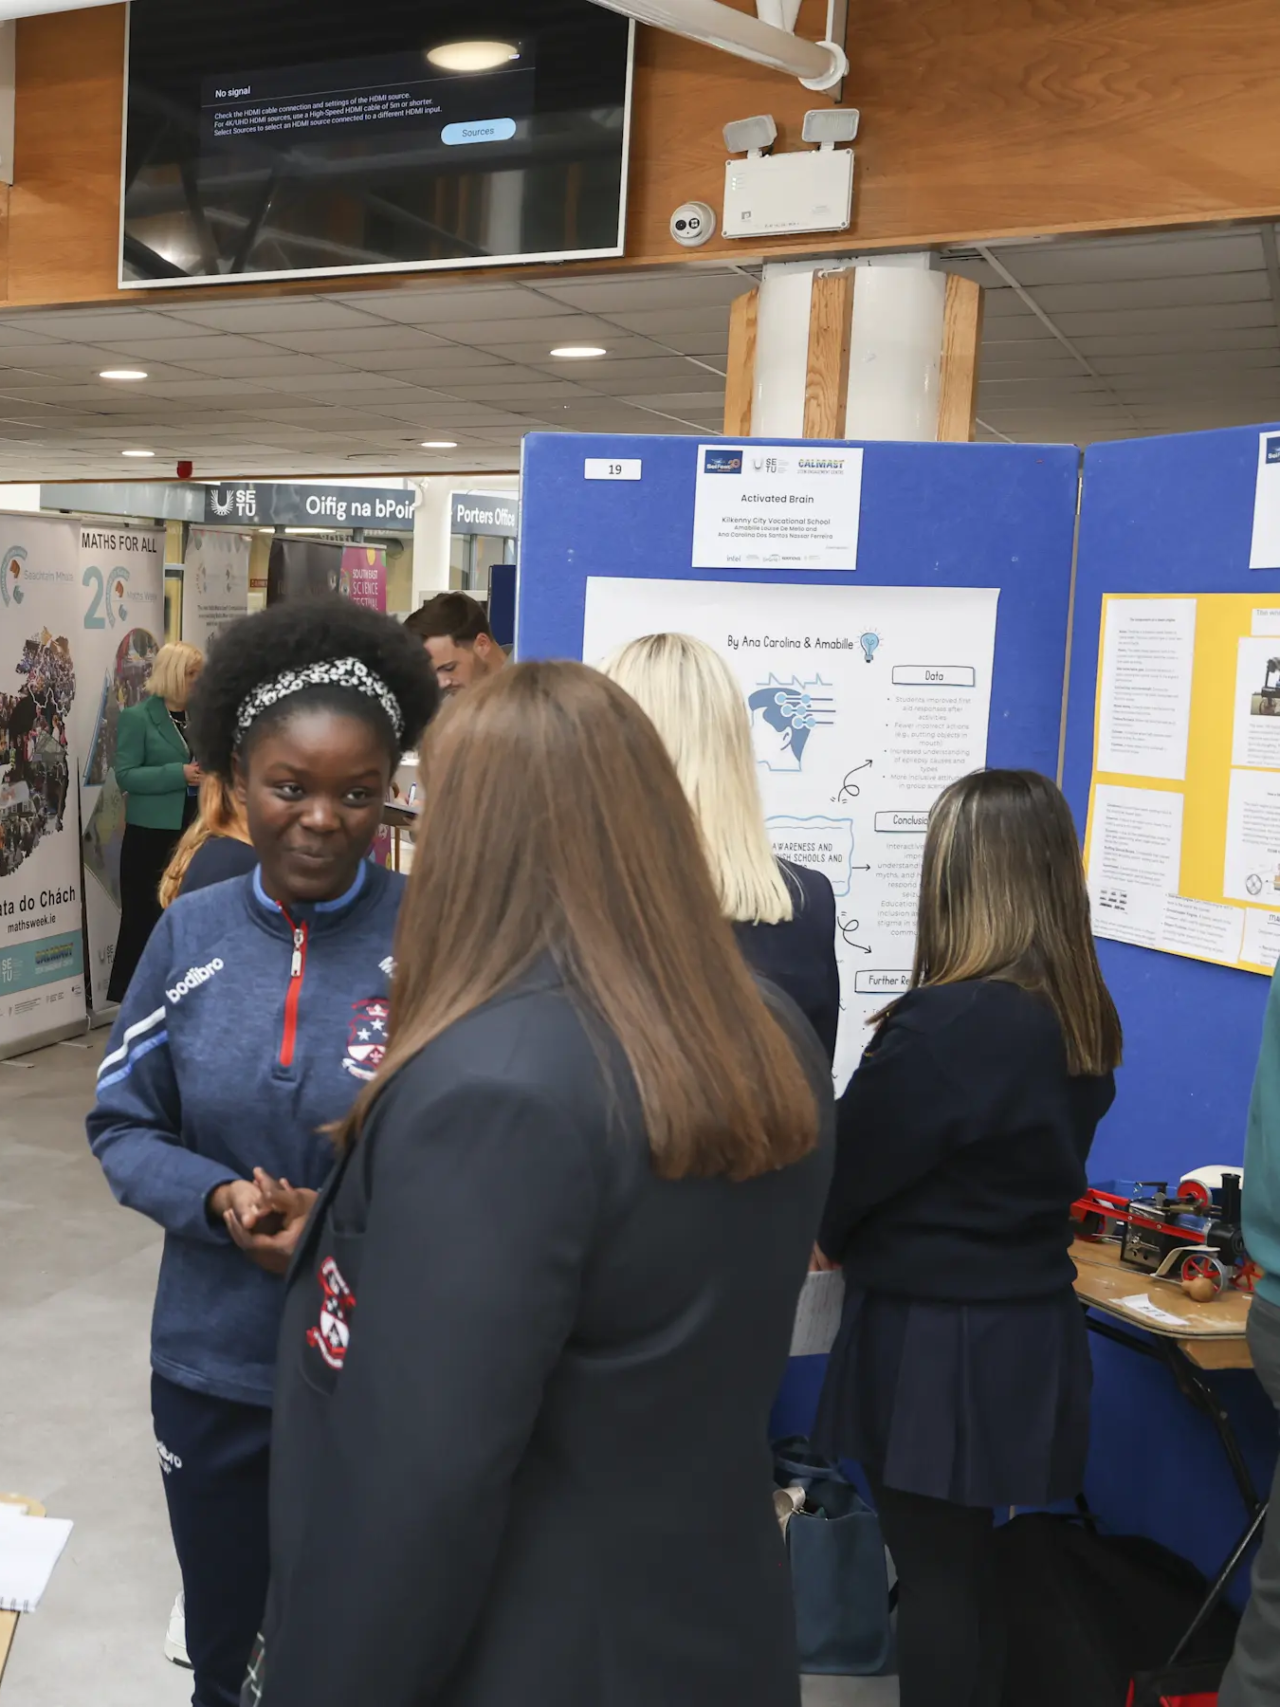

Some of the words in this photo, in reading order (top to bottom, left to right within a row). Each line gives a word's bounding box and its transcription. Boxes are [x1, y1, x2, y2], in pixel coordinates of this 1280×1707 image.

[215, 90, 226, 98] No
[228, 86, 251, 98] signal
[214, 111, 232, 120] Check
[234, 110, 243, 118] the
[262, 107, 277, 115] cable
[279, 103, 311, 113] connection
[312, 101, 323, 109] and
[325, 99, 349, 108] settings
[369, 94, 387, 102] HDMI
[250, 116, 266, 124] HDMI
[310, 108, 344, 118] High-Speed
[345, 106, 362, 114] HDMI
[364, 104, 380, 112] cable
[382, 102, 389, 110] of
[390, 101, 400, 109] 5m
[214, 128, 232, 136] Select
[233, 126, 257, 135] Sources
[257, 124, 264, 132] to
[265, 122, 282, 131] select
[292, 120, 309, 128] HDMI
[310, 118, 330, 126] source
[332, 113, 364, 124] connected
[378, 109, 404, 119] different
[405, 108, 423, 116] HDMI
[462, 127, 494, 137] Sources
[766, 458, 777, 466] SE
[798, 459, 845, 469] CALMAST
[608, 464, 622, 475] 19
[235, 489, 256, 502] SE
[741, 494, 787, 504] Activated
[789, 494, 814, 504] Brain
[236, 503, 256, 517] TU
[306, 496, 346, 521] Oifig
[351, 503, 372, 517] na
[457, 505, 493, 525] Porters
[494, 507, 515, 526] Office
[721, 517, 751, 525] Kilkenny
[753, 517, 767, 525] City
[82, 532, 117, 550] MATHS
[119, 535, 138, 552] FOR
[141, 538, 157, 553] ALL
[353, 582, 378, 595] SCIENCE
[727, 635, 739, 650] By
[742, 636, 761, 648] Ana
[763, 636, 801, 649] Carolina
[804, 637, 811, 648] &
[815, 638, 853, 650] Amabille
[925, 671, 944, 681] Data
[772, 843, 816, 851] AWARENESS
[818, 843, 833, 852] AND
[794, 853, 825, 862] SCHOOLS
[828, 854, 843, 863] AND
[20, 895, 35, 912] do
[40, 885, 76, 908] Chách
[7, 913, 56, 934] mathsweek.ie
[2, 957, 13, 971] SE
[2, 970, 13, 983] TU
[165, 957, 224, 1004] bodibro
[869, 974, 899, 986] Further
